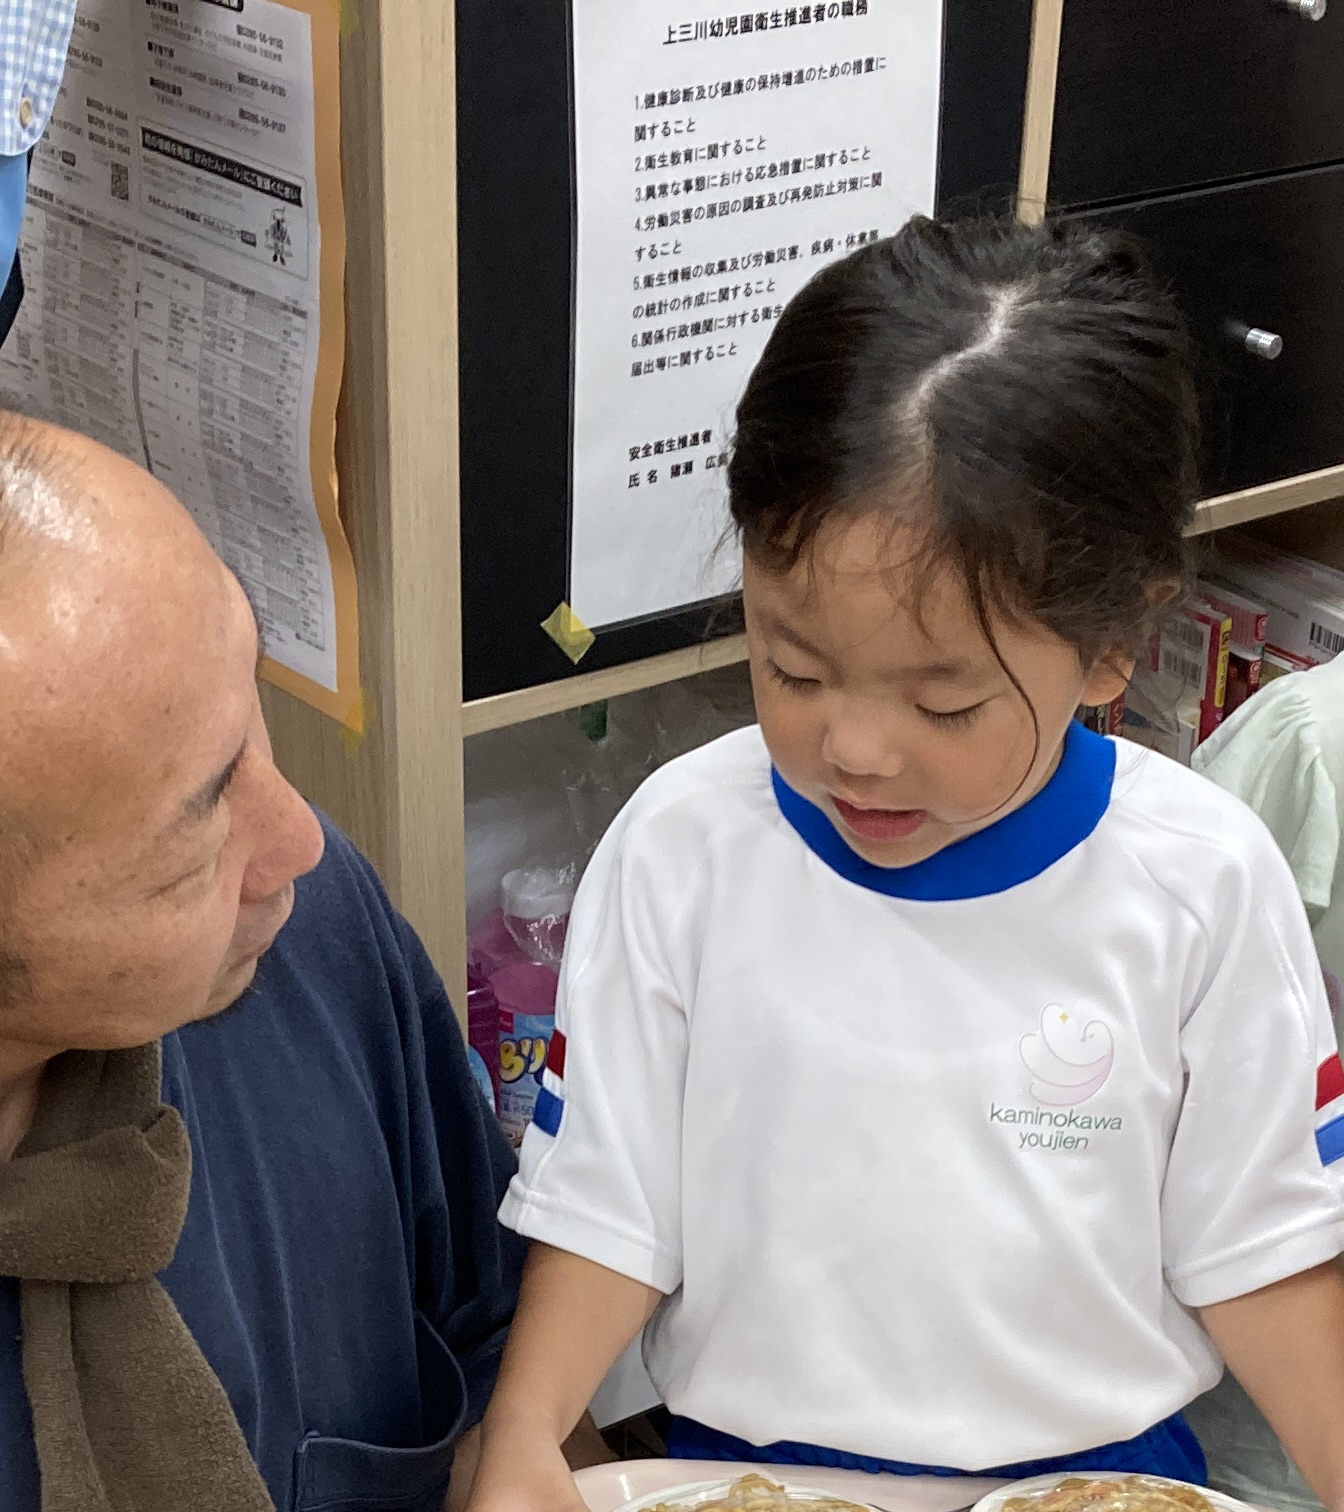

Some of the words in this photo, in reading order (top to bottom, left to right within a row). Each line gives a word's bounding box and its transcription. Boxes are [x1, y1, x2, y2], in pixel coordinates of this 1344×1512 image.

[634, 117, 696, 143] 関すること
[635, 240, 682, 262] すること
[989, 1101, 1122, 1130] kaminokawa
[1019, 1130, 1089, 1150] youjien
